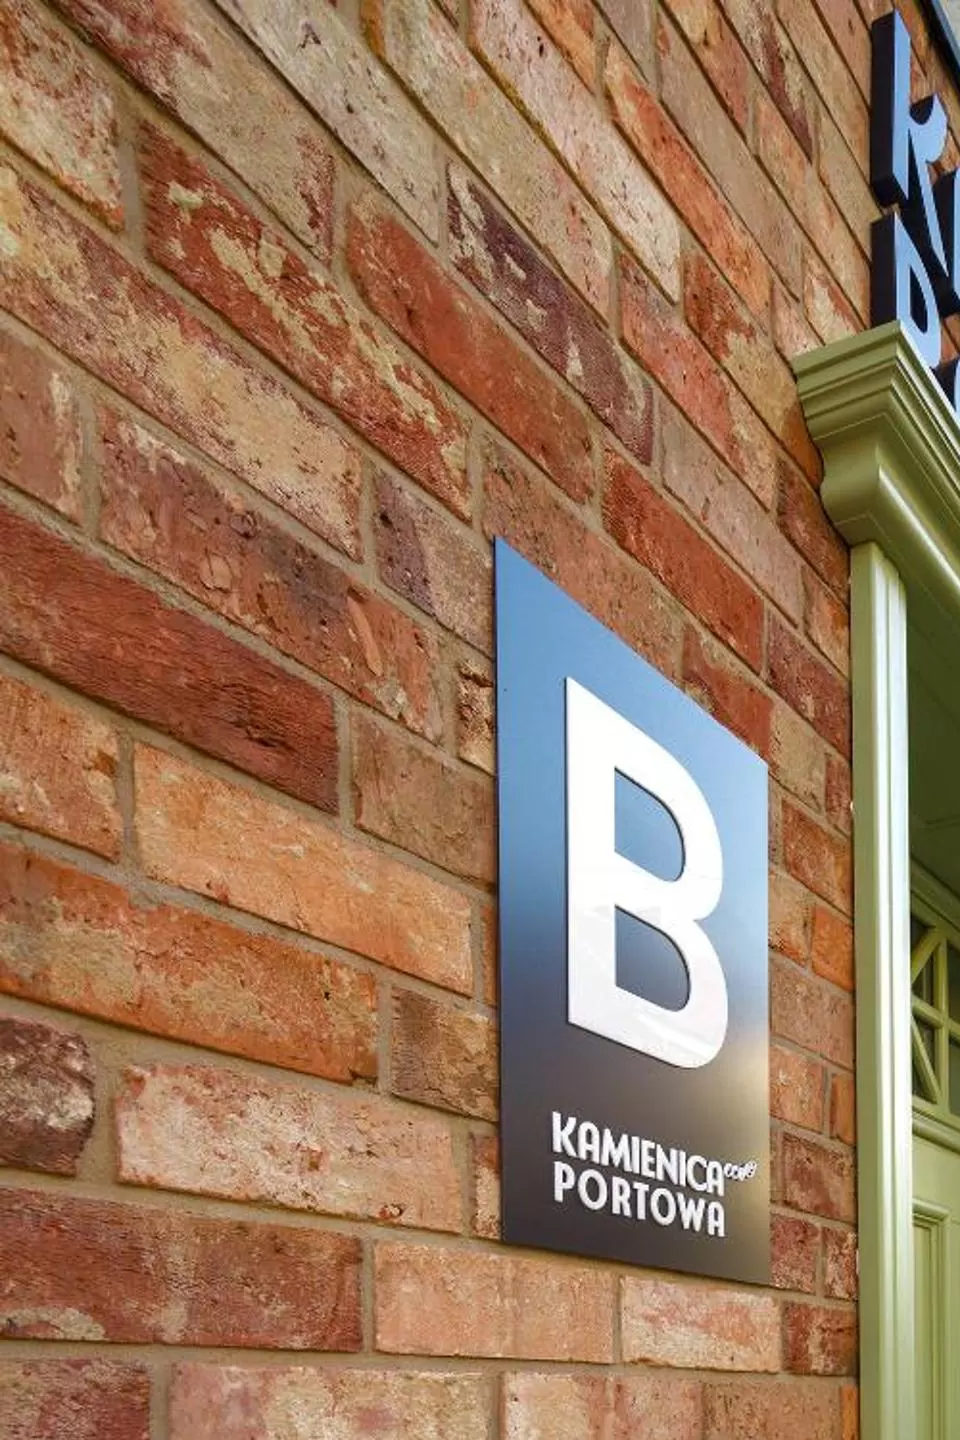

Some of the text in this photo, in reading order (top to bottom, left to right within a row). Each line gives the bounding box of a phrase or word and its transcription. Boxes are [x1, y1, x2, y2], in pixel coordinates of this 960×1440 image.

[566, 677, 728, 1068] B
[552, 1111, 725, 1197] KAMIENICA
[554, 1160, 725, 1238] PORTOWA
